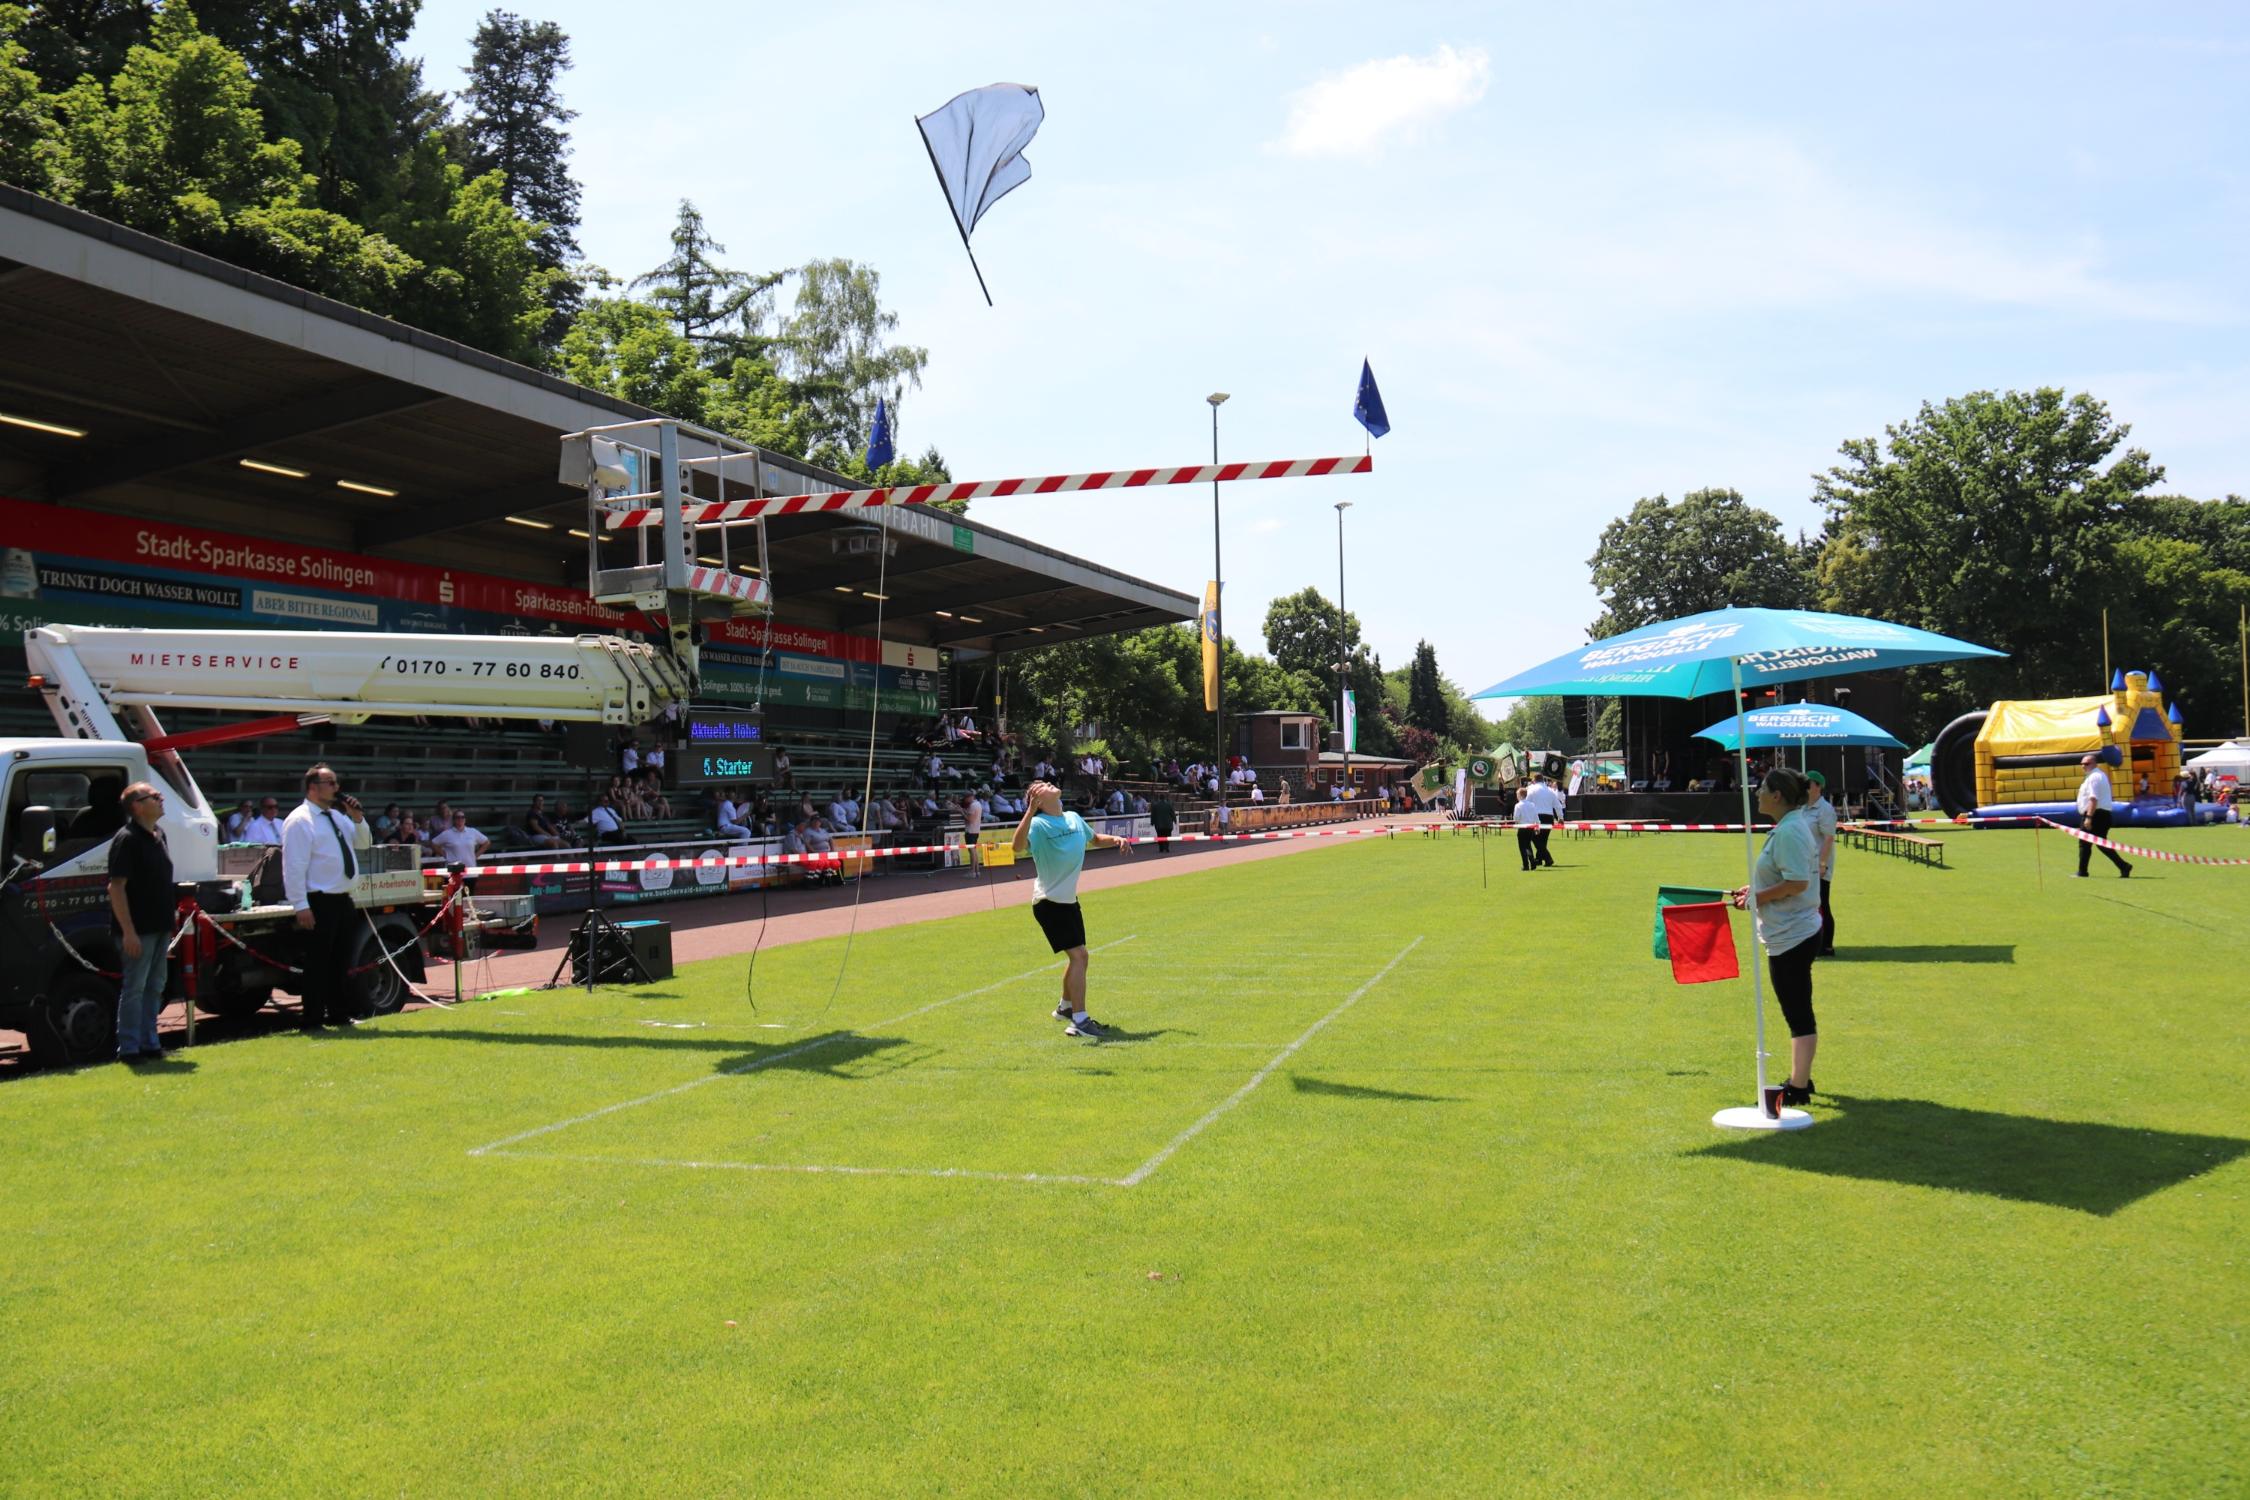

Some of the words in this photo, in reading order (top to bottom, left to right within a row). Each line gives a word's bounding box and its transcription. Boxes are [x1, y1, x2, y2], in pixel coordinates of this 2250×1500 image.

[136, 530, 296, 575] Stadt-Sparkasse
[299, 555, 374, 588] Solingen
[40, 569, 97, 590] TRINKT
[100, 577, 141, 596] DOCH
[143, 582, 193, 601] WASSER
[195, 588, 240, 607] WOLLT.
[256, 596, 286, 612] ABER
[288, 599, 320, 614] BITTE
[793, 632, 828, 653] Solingen
[1579, 625, 1740, 663] BERGISCHE
[130, 653, 299, 669] MIETSERVICE
[396, 660, 446, 675] 0170
[472, 661, 497, 676] 77
[506, 663, 531, 677] 60
[540, 664, 580, 680] 840
[1747, 714, 1841, 722] BERGISCHE
[691, 721, 731, 739] Aktuelle
[703, 756, 714, 776] 5.
[716, 756, 753, 776] Starter
